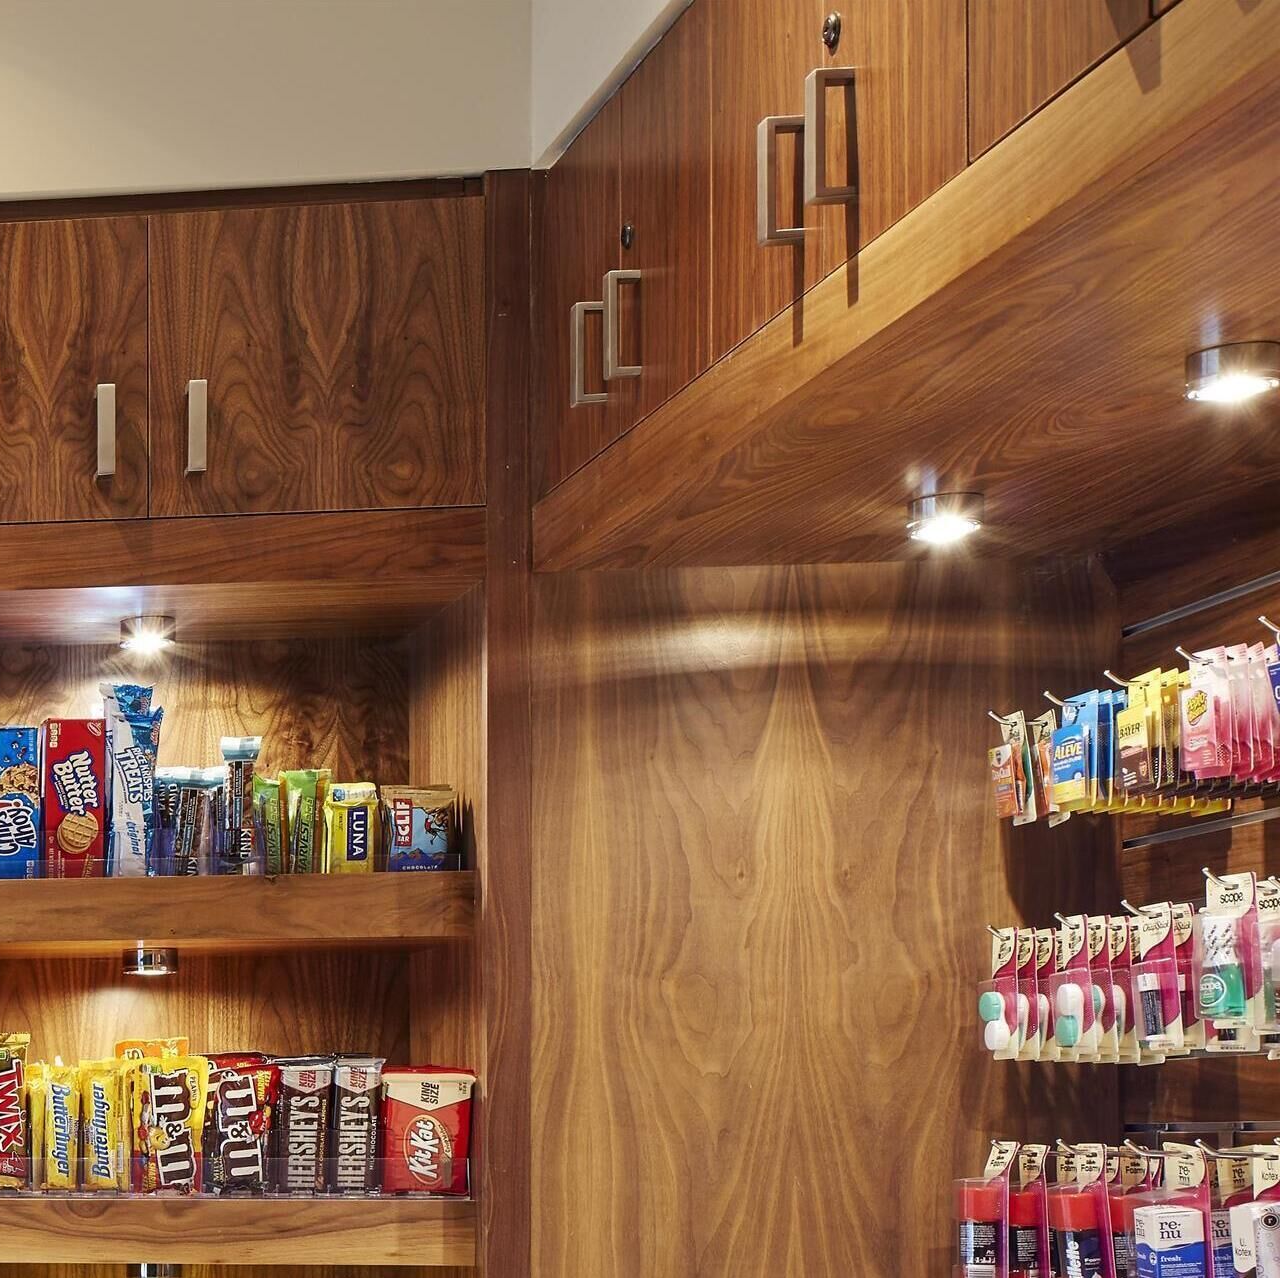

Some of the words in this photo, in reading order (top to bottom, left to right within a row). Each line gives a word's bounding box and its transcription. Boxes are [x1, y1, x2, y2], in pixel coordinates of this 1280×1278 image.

[1120, 722, 1141, 739] BAYER
[1054, 742, 1082, 760] ALEVE
[53, 759, 87, 816] Butter
[70, 750, 99, 809] Nutter
[115, 750, 143, 803] TREATS
[140, 763, 153, 801] KRISPIES
[352, 810, 365, 857] LUNA
[397, 799, 412, 837] CLIF
[240, 828, 252, 864] KIND
[397, 836, 410, 844] BAR
[1220, 891, 1244, 905] scope
[358, 1067, 368, 1089] SIZE
[420, 1082, 430, 1103] KING
[430, 1083, 440, 1104] SIZE
[51, 1084, 71, 1178] Butterfinger
[91, 1082, 111, 1179] Butterfinger
[287, 1096, 320, 1188] HERSHEY'S
[336, 1096, 371, 1188] HERSHEY'S
[1160, 1231, 1182, 1240] nu
[1160, 1255, 1182, 1263] fresh
